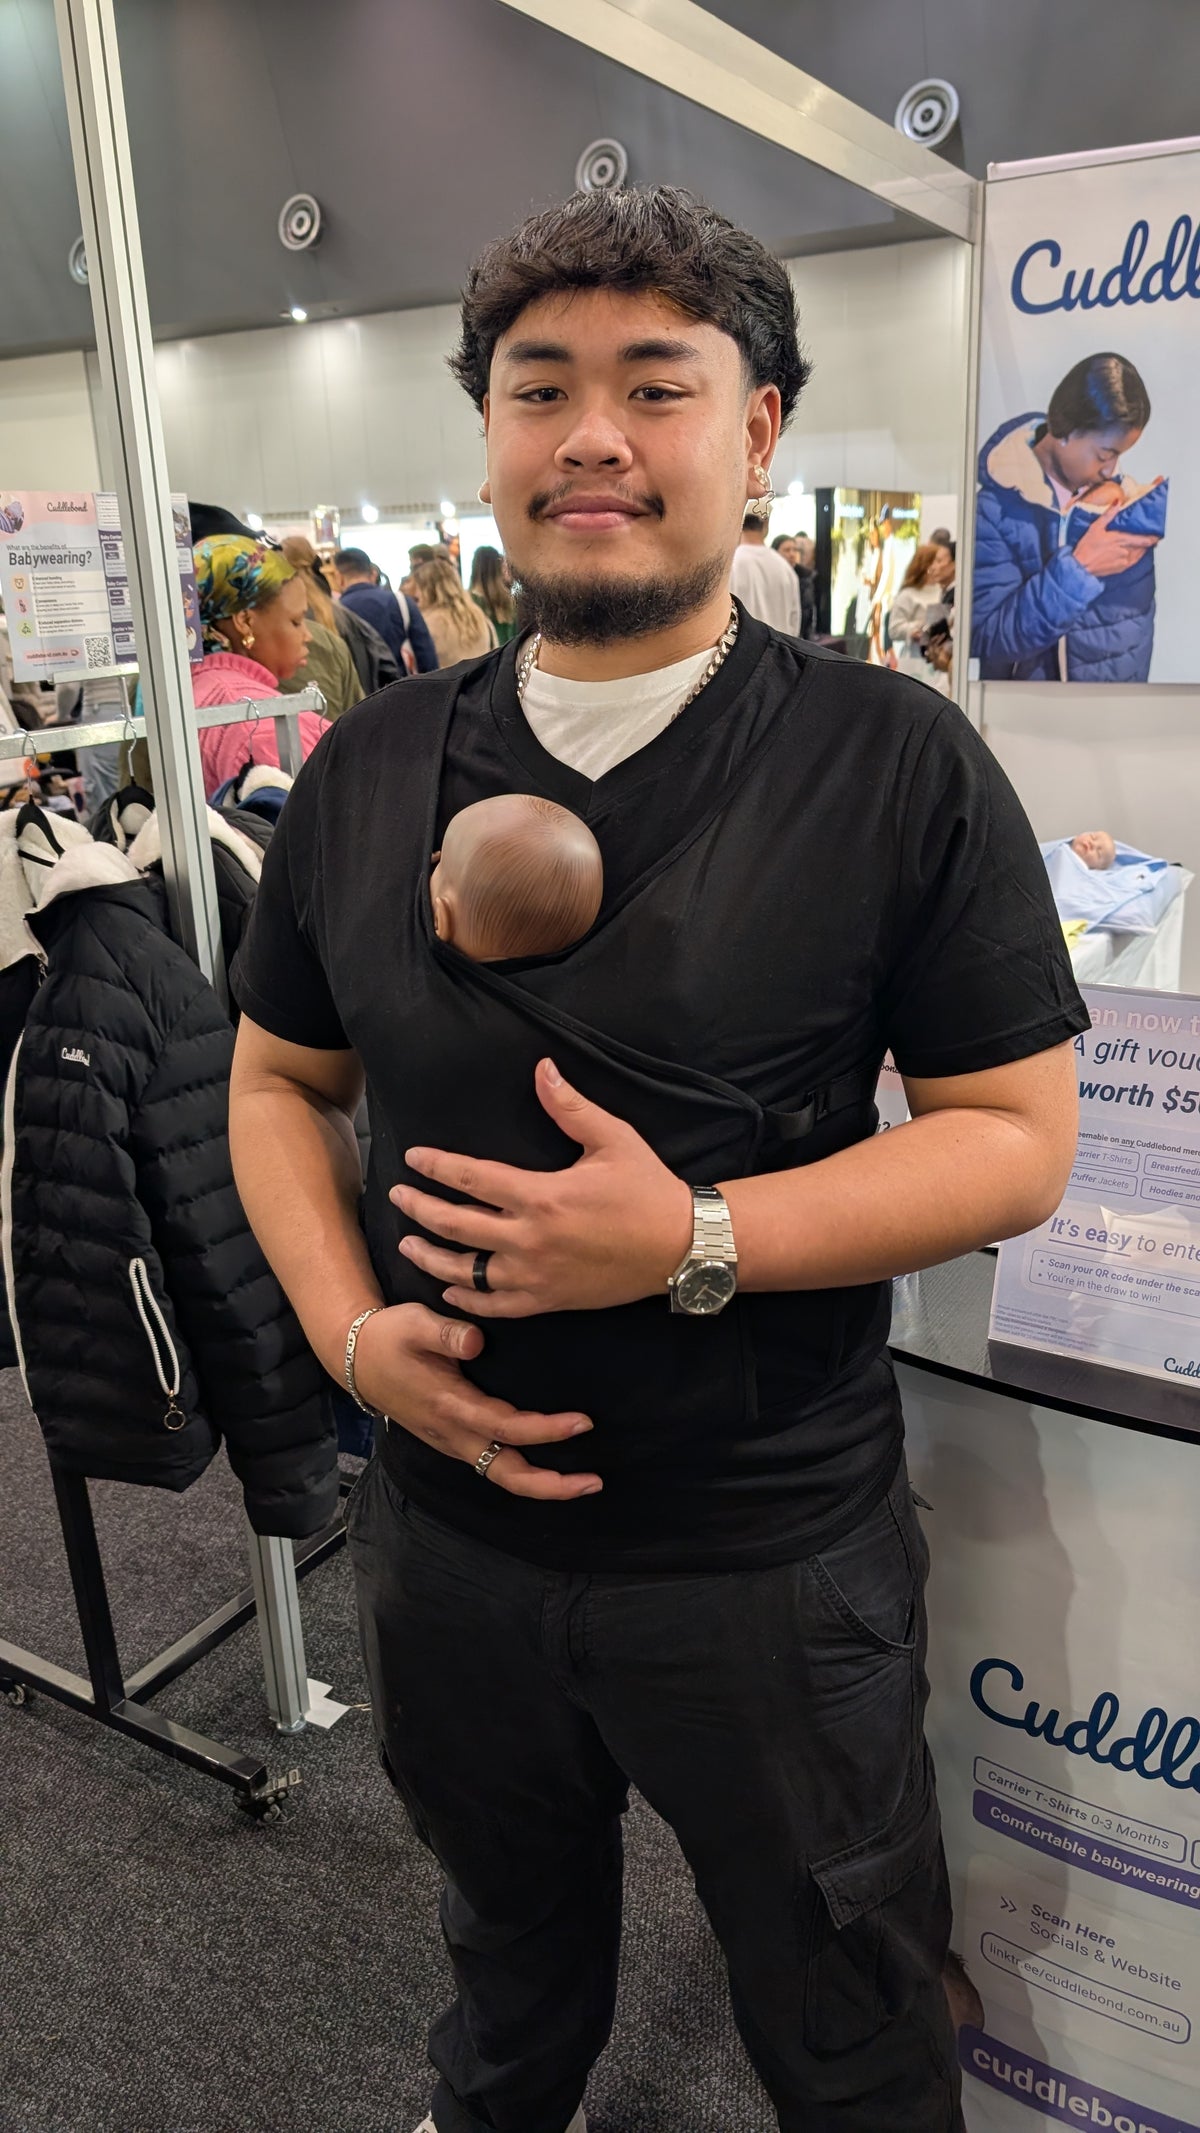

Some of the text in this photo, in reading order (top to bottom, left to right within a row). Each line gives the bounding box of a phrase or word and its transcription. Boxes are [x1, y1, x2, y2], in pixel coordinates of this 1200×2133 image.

[47, 502, 88, 512] Cuddlebond
[9, 551, 92, 568] Babywearing?
[1126, 1011, 1183, 1033] now
[1074, 1034, 1085, 1057] A
[1093, 1038, 1140, 1065] gift
[1079, 1081, 1200, 1114] worth $5
[1103, 1153, 1133, 1165] T-Shirts
[1110, 1136, 1120, 1144] on
[1121, 1138, 1135, 1148] any
[1136, 1140, 1182, 1153] Cuddlebond
[1071, 1172, 1130, 1189] Puffer Jackets
[1151, 1161, 1200, 1177] Breastfeedi
[1149, 1185, 1183, 1198] Hoodies
[1050, 1217, 1081, 1238] It's
[1085, 1227, 1132, 1251] easy
[1137, 1234, 1156, 1252] to
[1047, 1272, 1161, 1304] You're in the draw to win!
[1048, 1258, 1071, 1271] Scan
[1072, 1264, 1093, 1277] your
[1095, 1268, 1109, 1279] QR
[1110, 1272, 1134, 1284] code
[1136, 1277, 1164, 1290] under
[1165, 1281, 1181, 1293] the
[987, 1770, 1170, 1850] Carrier T-Shirts 0-3 Months
[990, 1806, 1200, 1899] Comfortable babywearing
[1030, 1904, 1116, 1948] Scan Here
[1029, 1921, 1182, 1991] Socials & Website
[990, 1942, 1180, 2033] linktr.ee/cuddlebond.com.au
